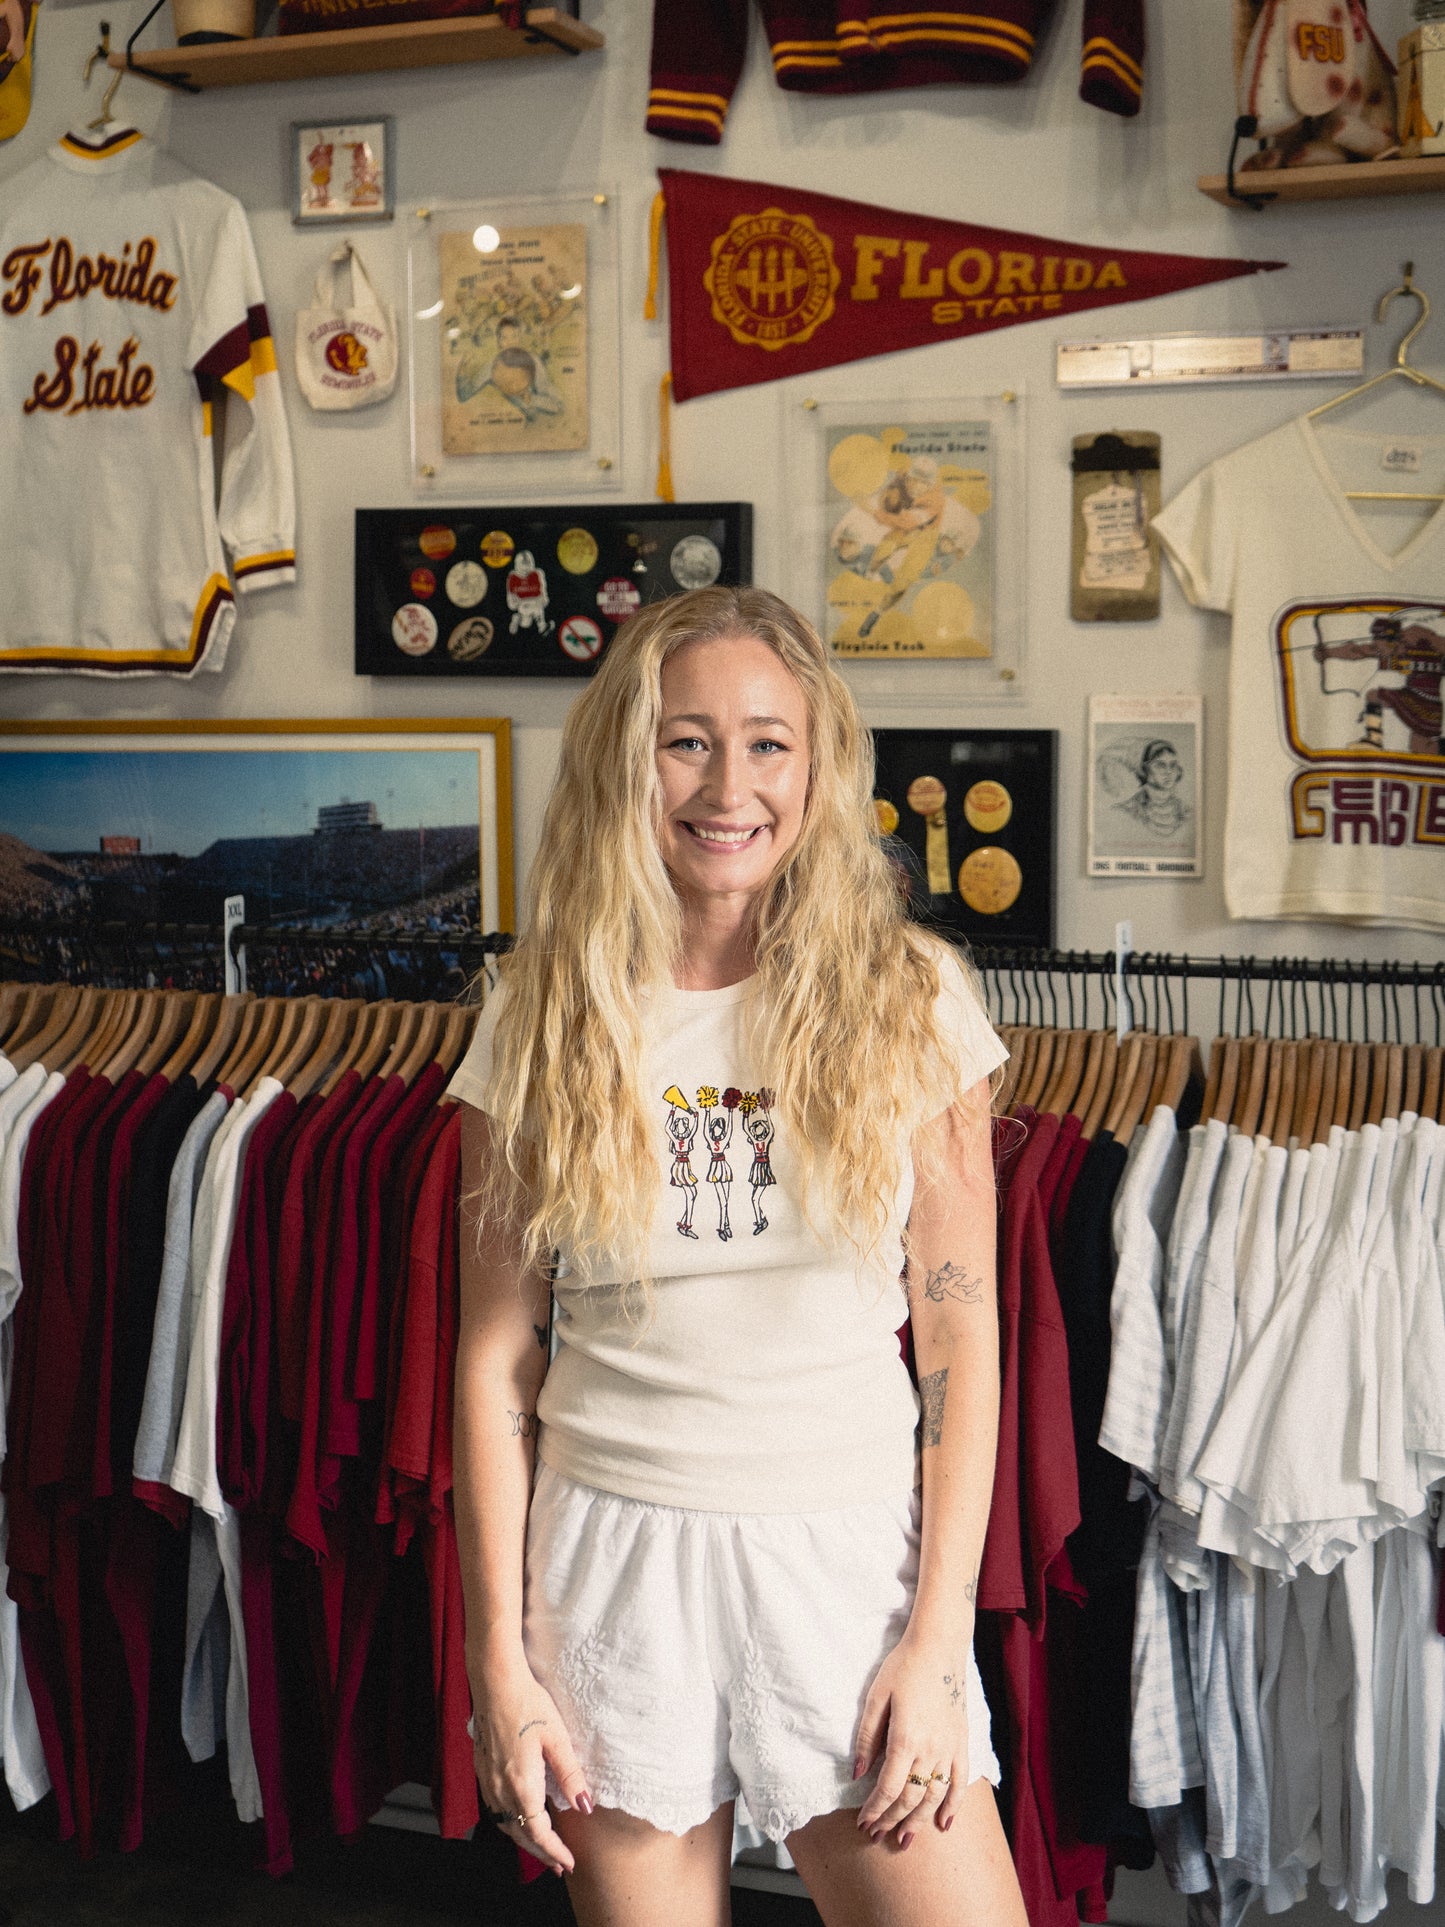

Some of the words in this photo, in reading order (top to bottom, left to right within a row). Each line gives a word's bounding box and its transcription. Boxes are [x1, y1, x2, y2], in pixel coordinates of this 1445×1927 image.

[1294, 22, 1346, 64] FSU
[731, 218, 783, 247] STATE
[2, 235, 179, 318] Florida
[851, 234, 1128, 300] FLORIDA
[931, 294, 1063, 325] STATE
[23, 331, 157, 416] State
[891, 443, 942, 454] Florida
[831, 641, 890, 653] Virginia
[227, 903, 243, 919] XXL
[713, 1140, 721, 1152] S
[755, 1142, 766, 1153] U
